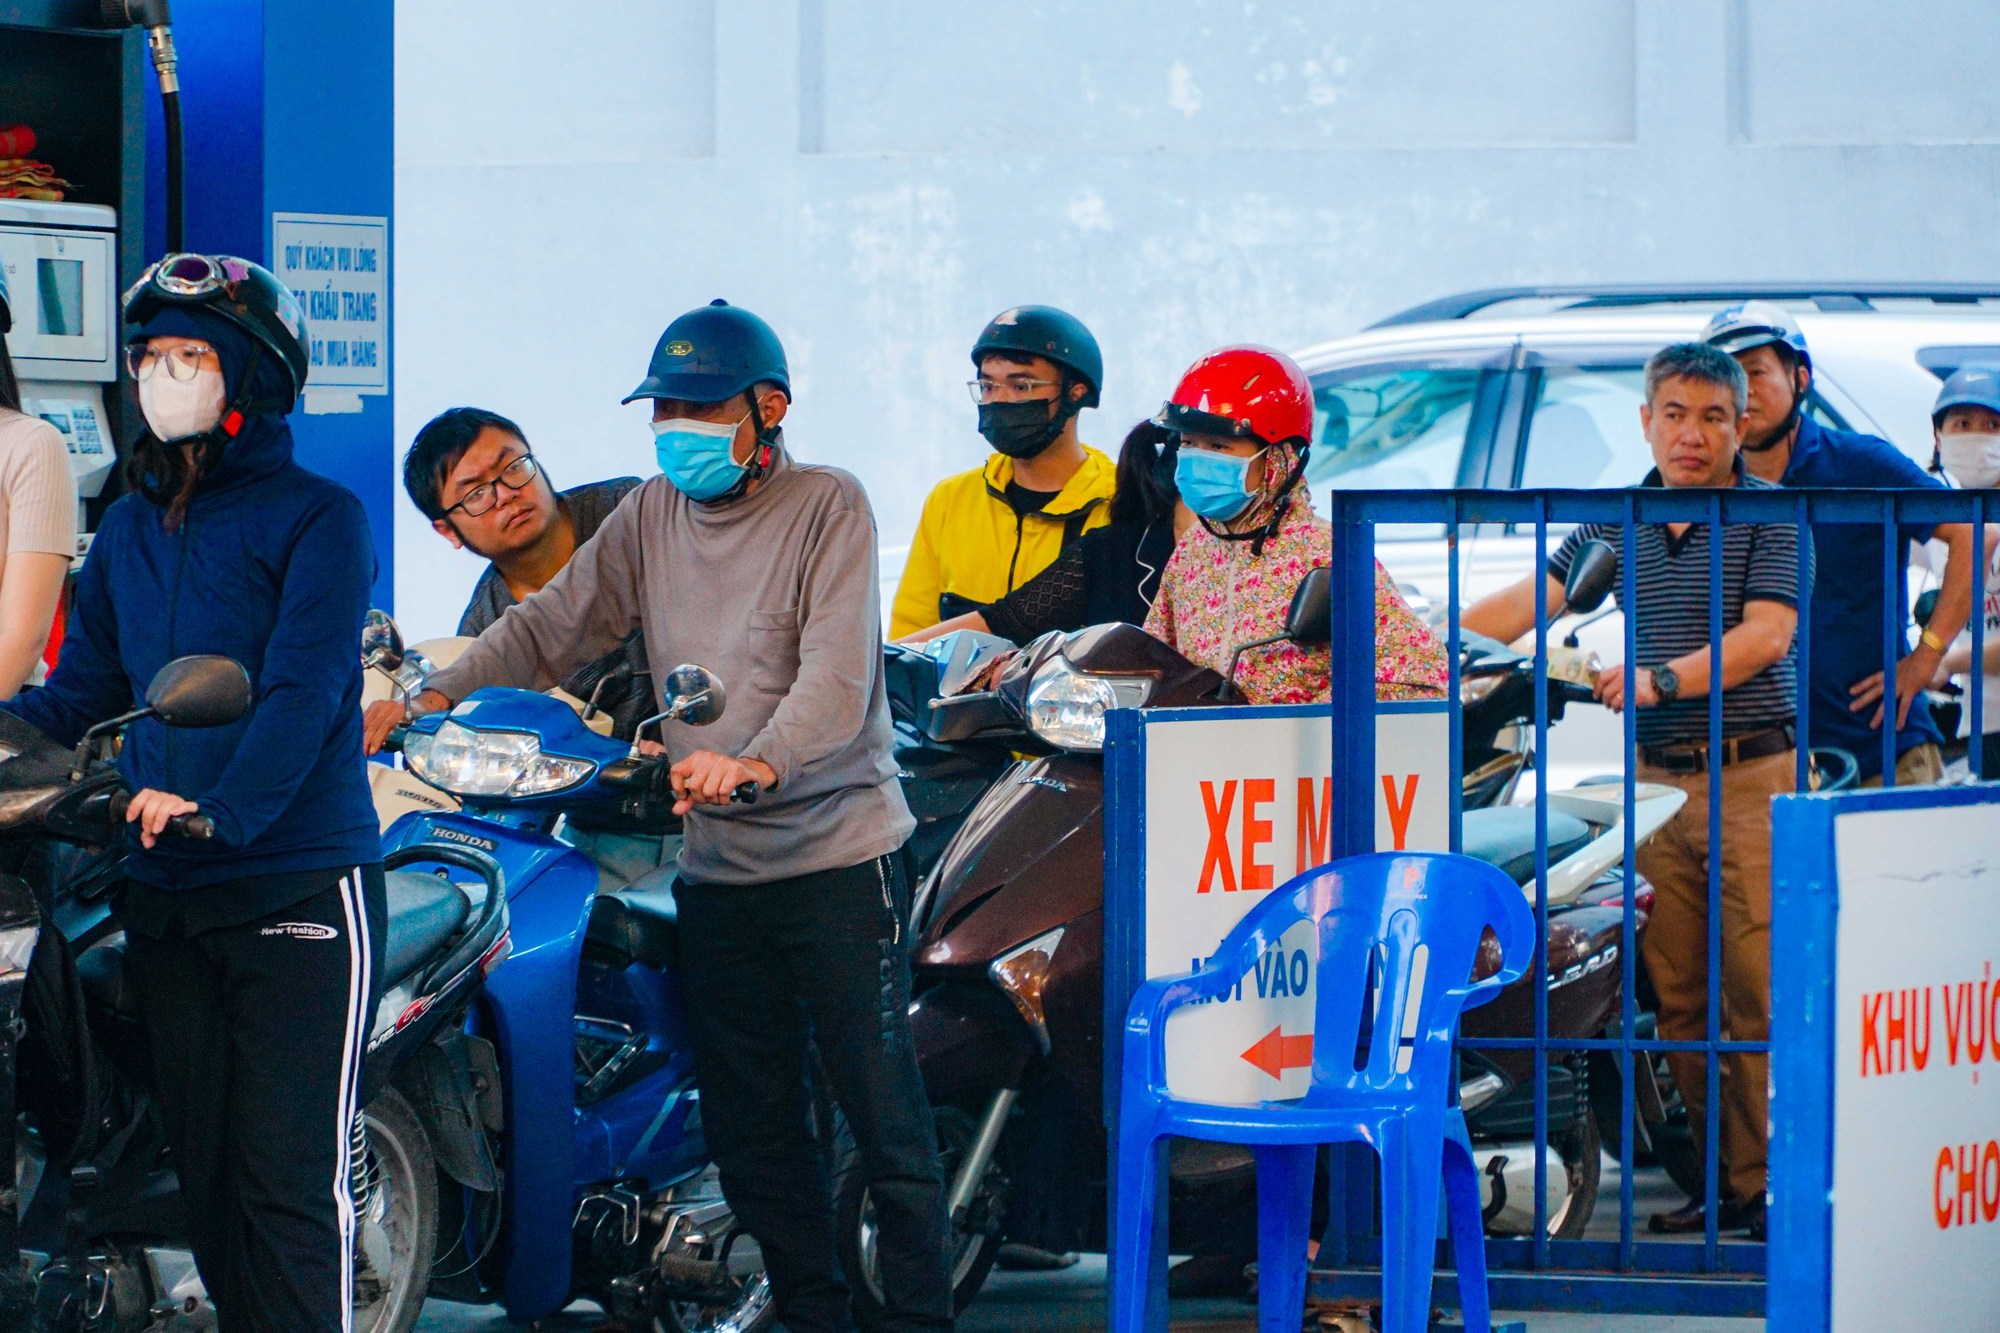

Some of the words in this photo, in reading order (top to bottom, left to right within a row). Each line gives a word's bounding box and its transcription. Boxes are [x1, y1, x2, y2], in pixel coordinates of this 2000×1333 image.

[285, 240, 302, 272] QUÝ
[305, 241, 335, 272] KHÁCH
[338, 247, 352, 272] VUI
[342, 291, 376, 322] TRANG
[327, 340, 348, 367] MUA
[432, 827, 494, 851] HONDA
[1197, 778, 1275, 894] XE
[1296, 774, 1420, 876] MY
[261, 927, 284, 936] New
[286, 925, 326, 937] fashion
[1860, 986, 1931, 1078] KHU
